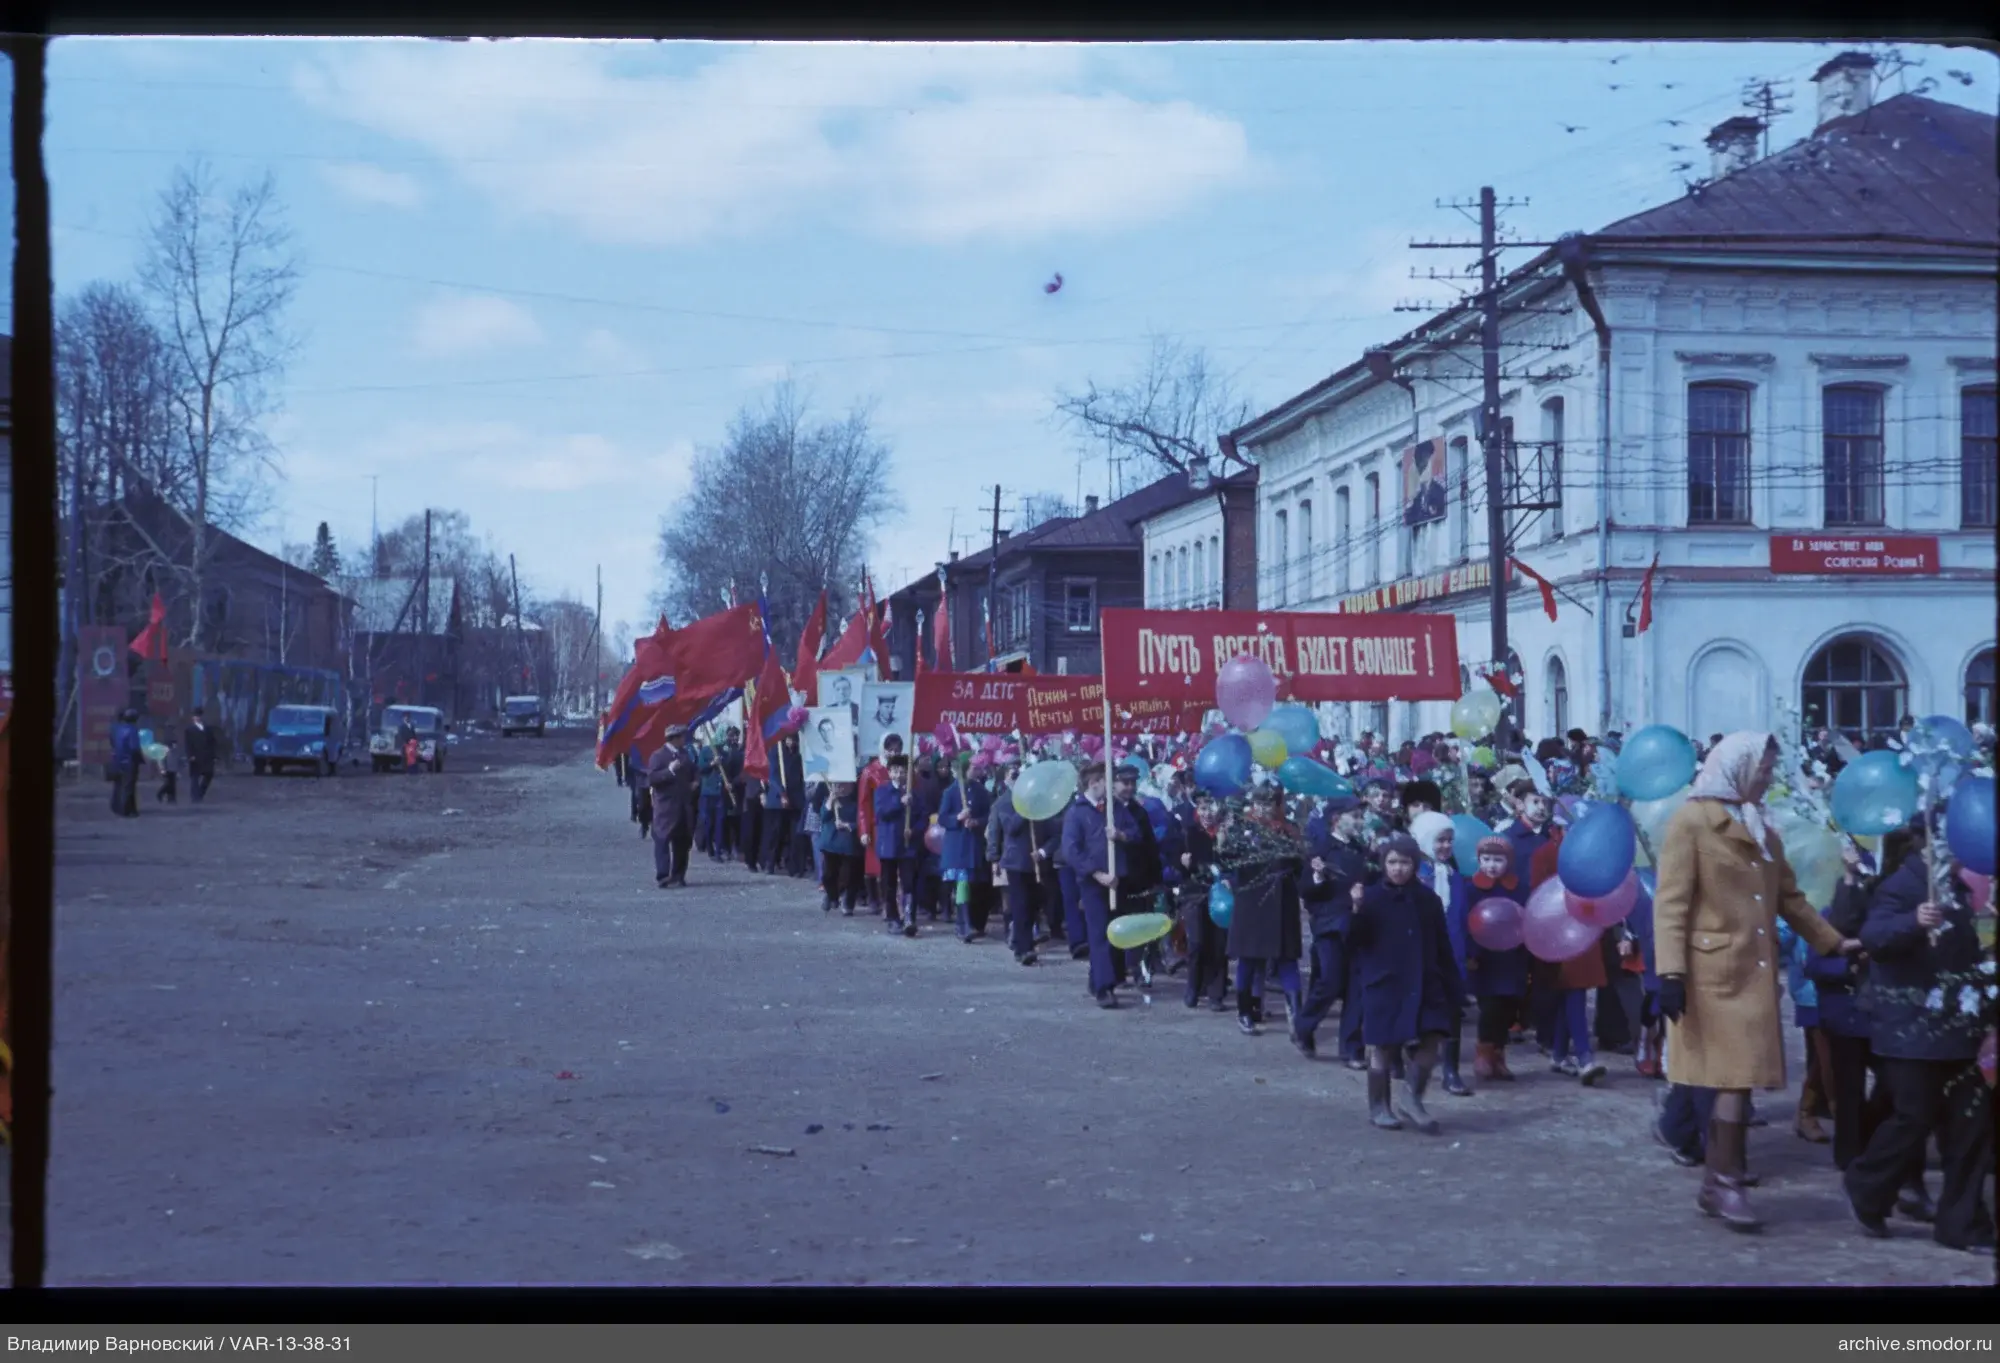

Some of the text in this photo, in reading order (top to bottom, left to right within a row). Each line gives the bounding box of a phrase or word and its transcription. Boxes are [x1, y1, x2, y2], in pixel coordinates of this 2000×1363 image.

[1396, 573, 1443, 605] ПАРТИЯ
[1296, 636, 1348, 676] БУДЕТ
[1352, 636, 1417, 676] СОЛНЦЕ
[952, 680, 1019, 701] ЗА ДЕТС
[1080, 684, 1104, 701] ПАР
